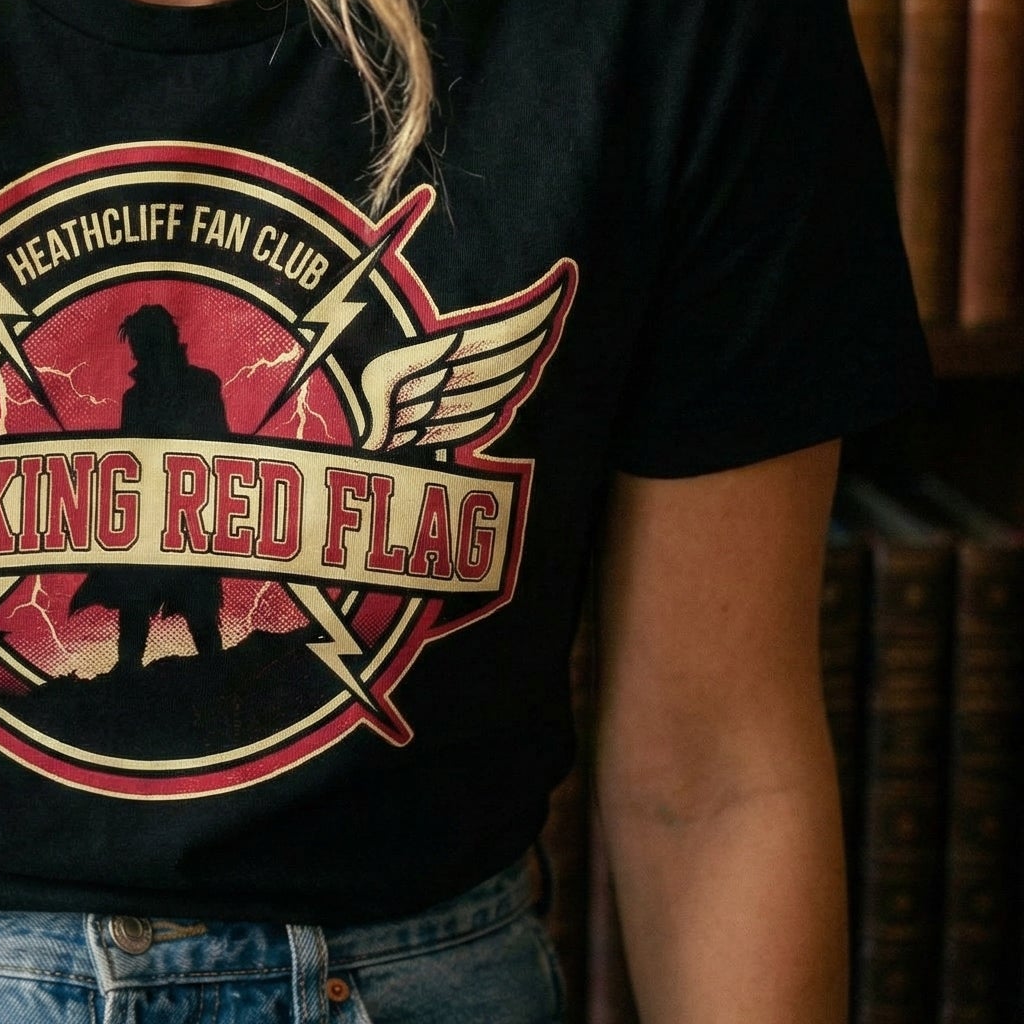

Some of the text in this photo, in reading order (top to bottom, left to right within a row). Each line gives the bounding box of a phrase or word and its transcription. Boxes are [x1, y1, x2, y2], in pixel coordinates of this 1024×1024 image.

[6, 203, 330, 291] HEATHCLIFF FAN CLUB
[160, 452, 305, 562] RED
[320, 467, 500, 582] FLAG
